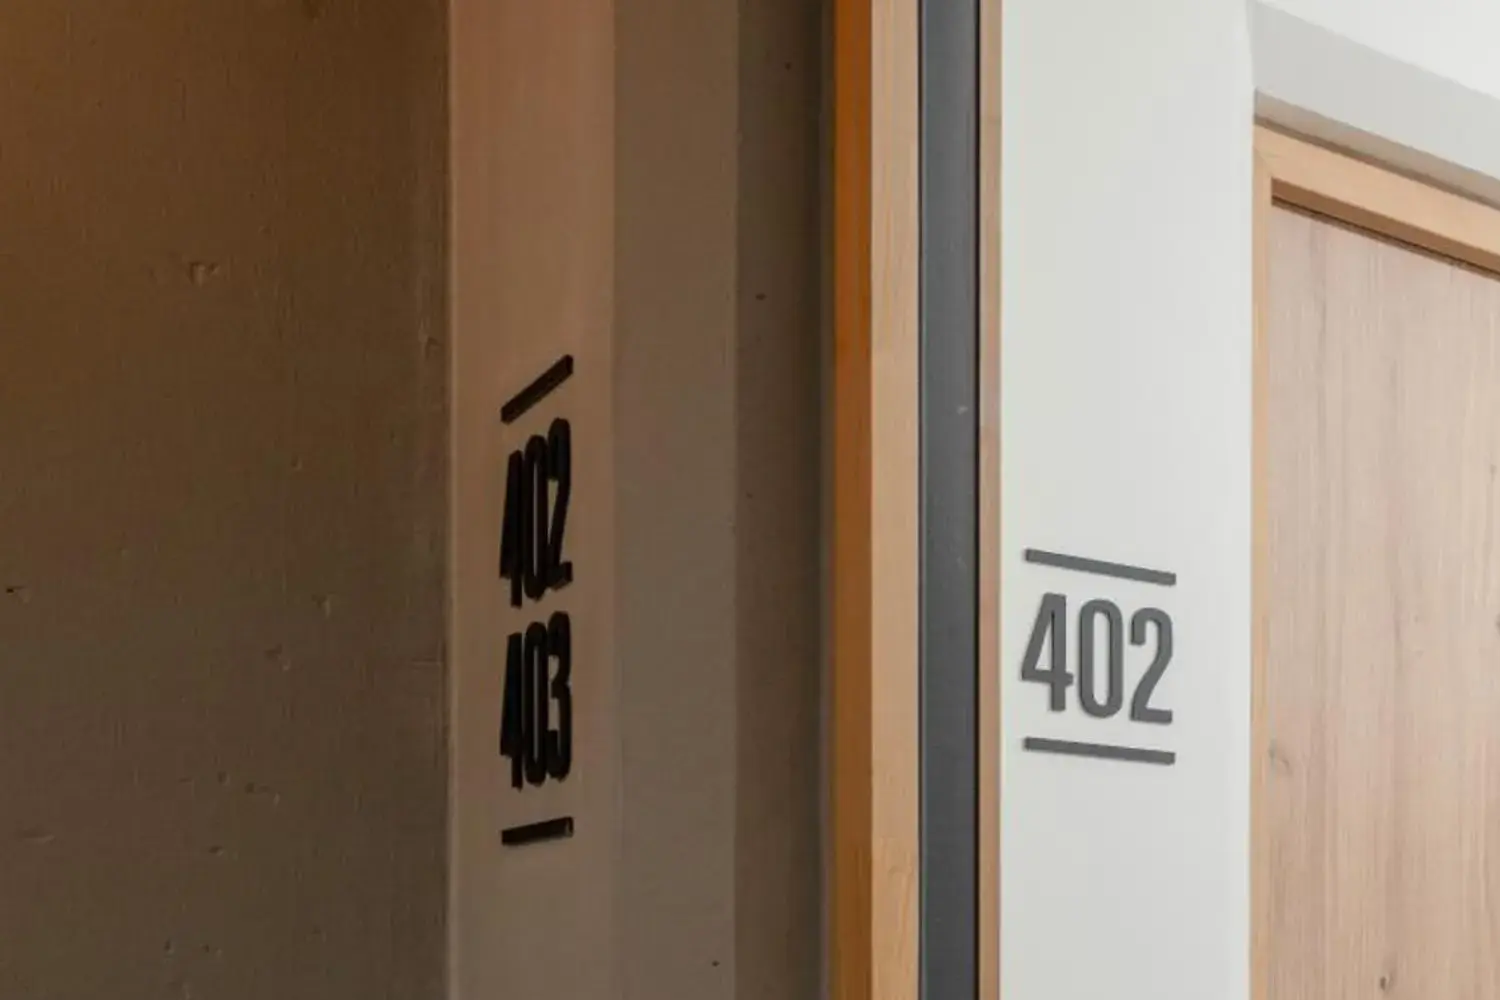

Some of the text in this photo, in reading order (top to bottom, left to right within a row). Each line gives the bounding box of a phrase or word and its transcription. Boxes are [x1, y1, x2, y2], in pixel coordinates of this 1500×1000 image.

[500, 417, 573, 607] 402
[500, 611, 572, 790] 403
[1021, 592, 1173, 725] 402
